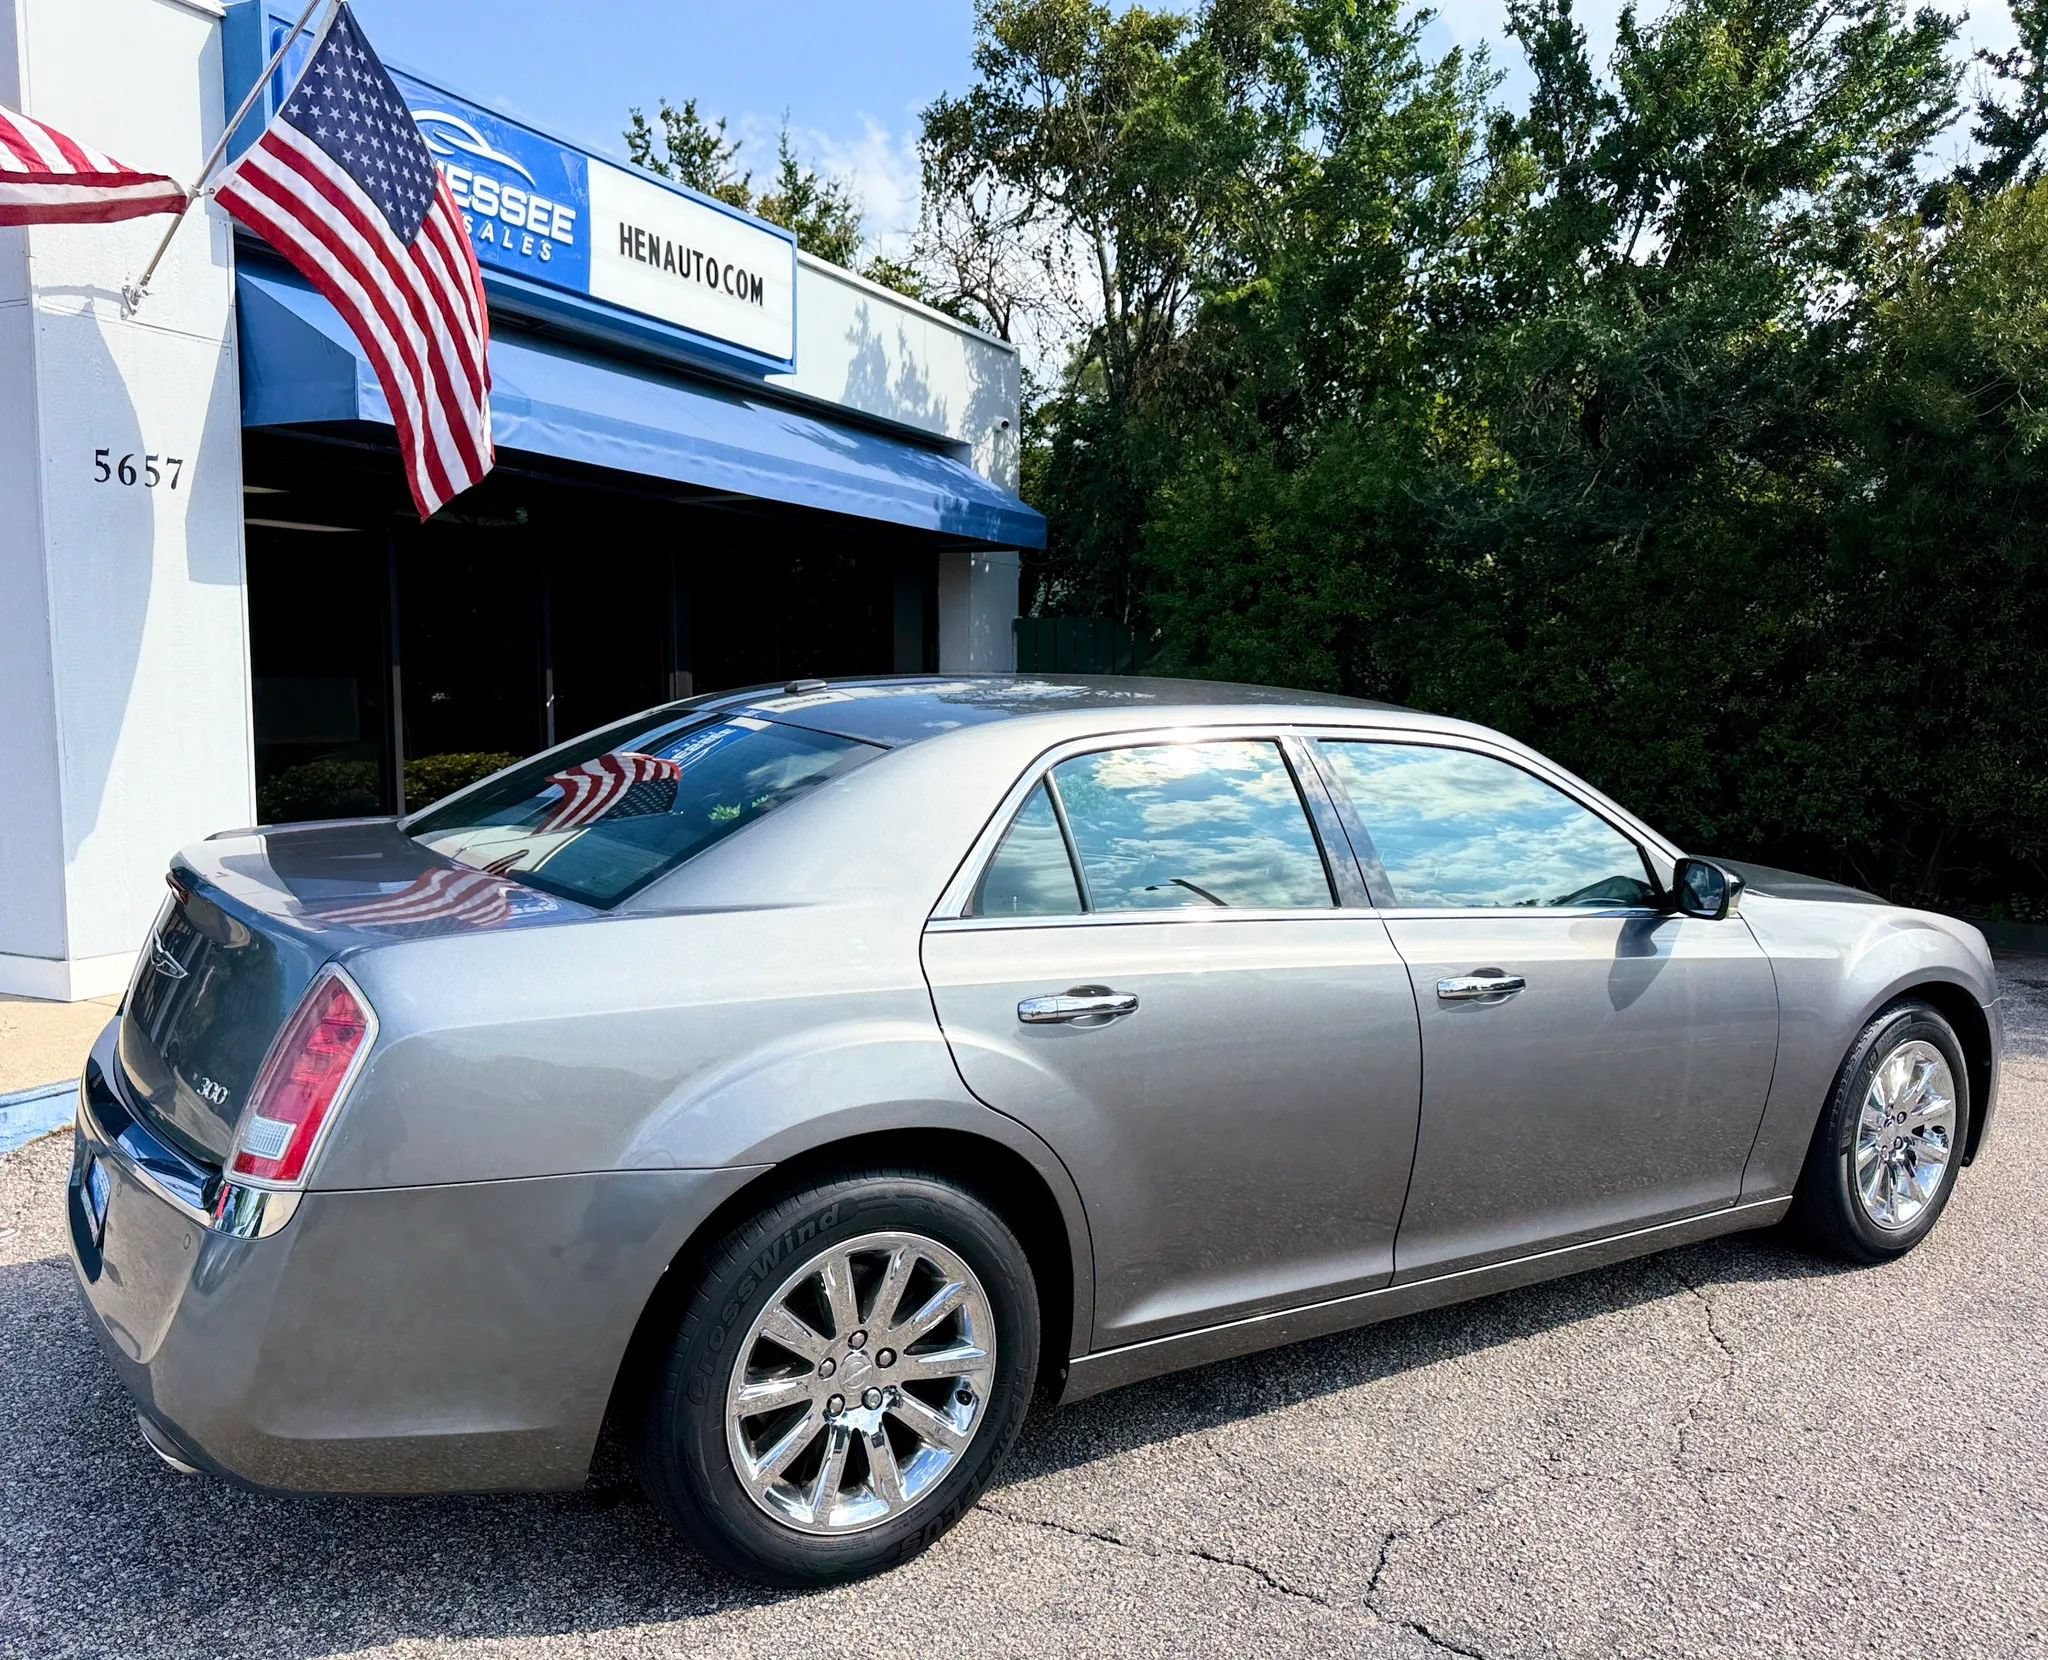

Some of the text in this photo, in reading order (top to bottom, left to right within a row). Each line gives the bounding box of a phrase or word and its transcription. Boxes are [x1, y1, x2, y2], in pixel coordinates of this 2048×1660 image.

[463, 215, 553, 261] SALES
[94, 448, 184, 490] 5657
[196, 1076, 229, 1105] 300
